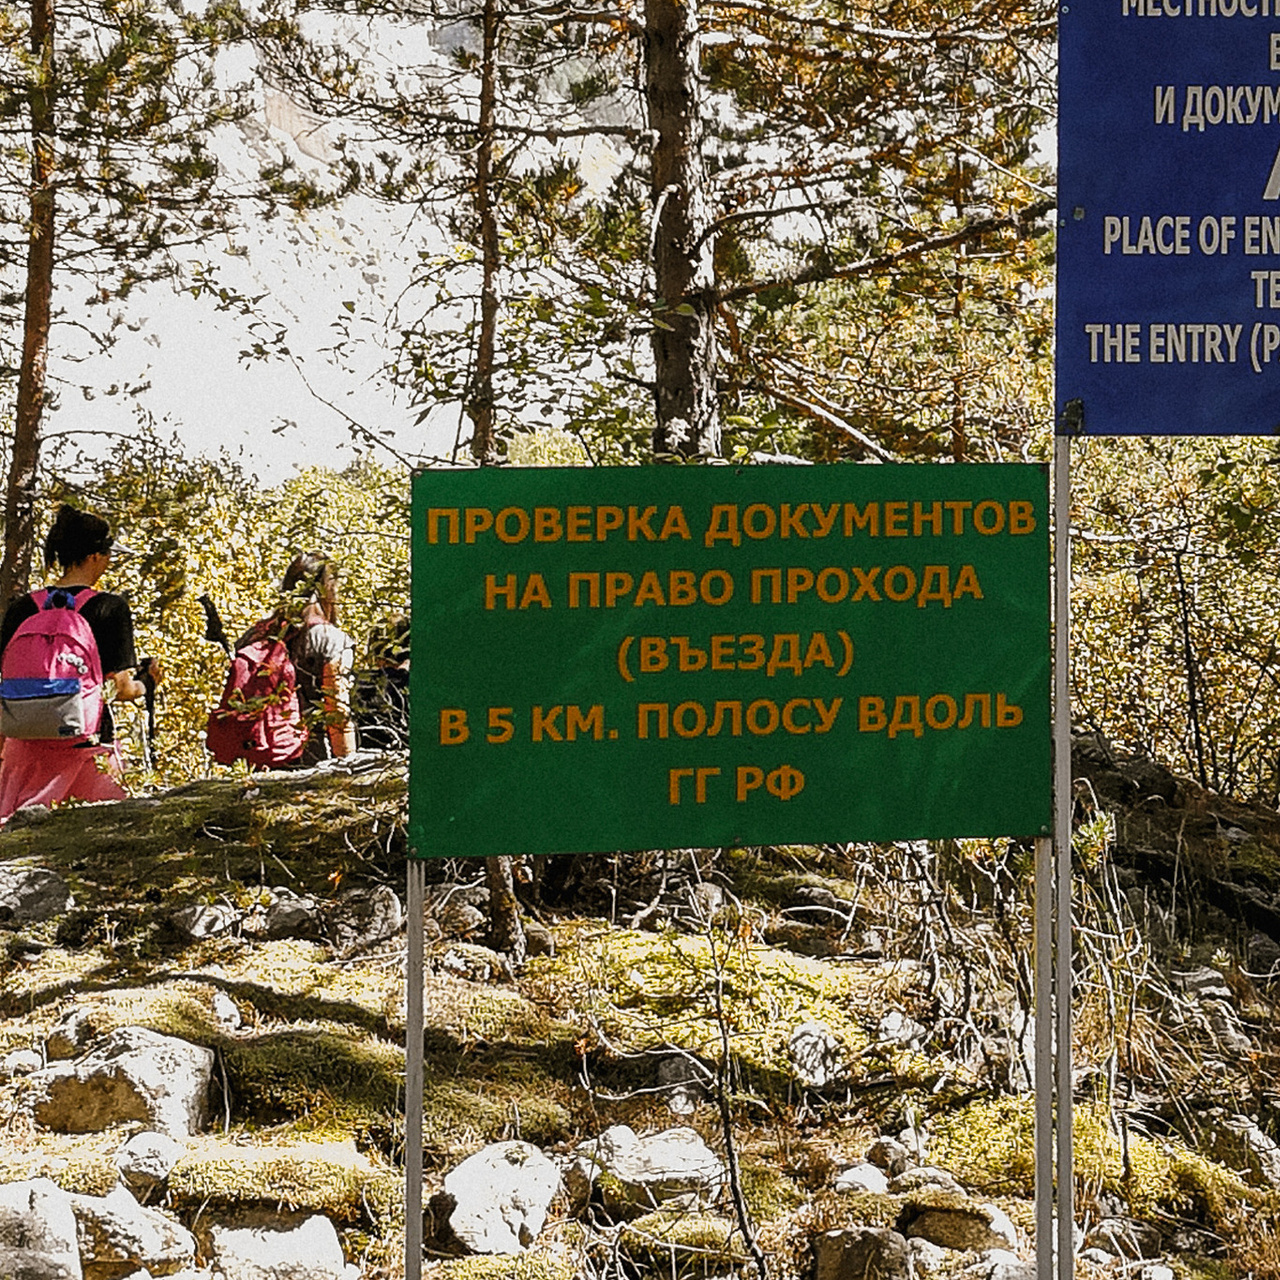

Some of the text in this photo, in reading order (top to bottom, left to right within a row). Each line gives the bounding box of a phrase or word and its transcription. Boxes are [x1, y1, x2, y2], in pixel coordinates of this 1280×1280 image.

[1156, 86, 1174, 123] И
[1105, 216, 1190, 254] PLACE
[1199, 216, 1235, 254] OF
[1085, 324, 1140, 362] THE
[1150, 324, 1242, 362] ENTRY
[428, 501, 1036, 547] ПРОВЕРКА ДОКУМЕНТОВ
[486, 566, 983, 609] НА ПРАВО ПРОХОДА
[618, 632, 853, 682] (ВЪЕЗДА)
[441, 694, 1023, 744] В 5 КМ. ПОЛОСУ ВДОЛЬ
[670, 765, 804, 804] ГГ РФ
